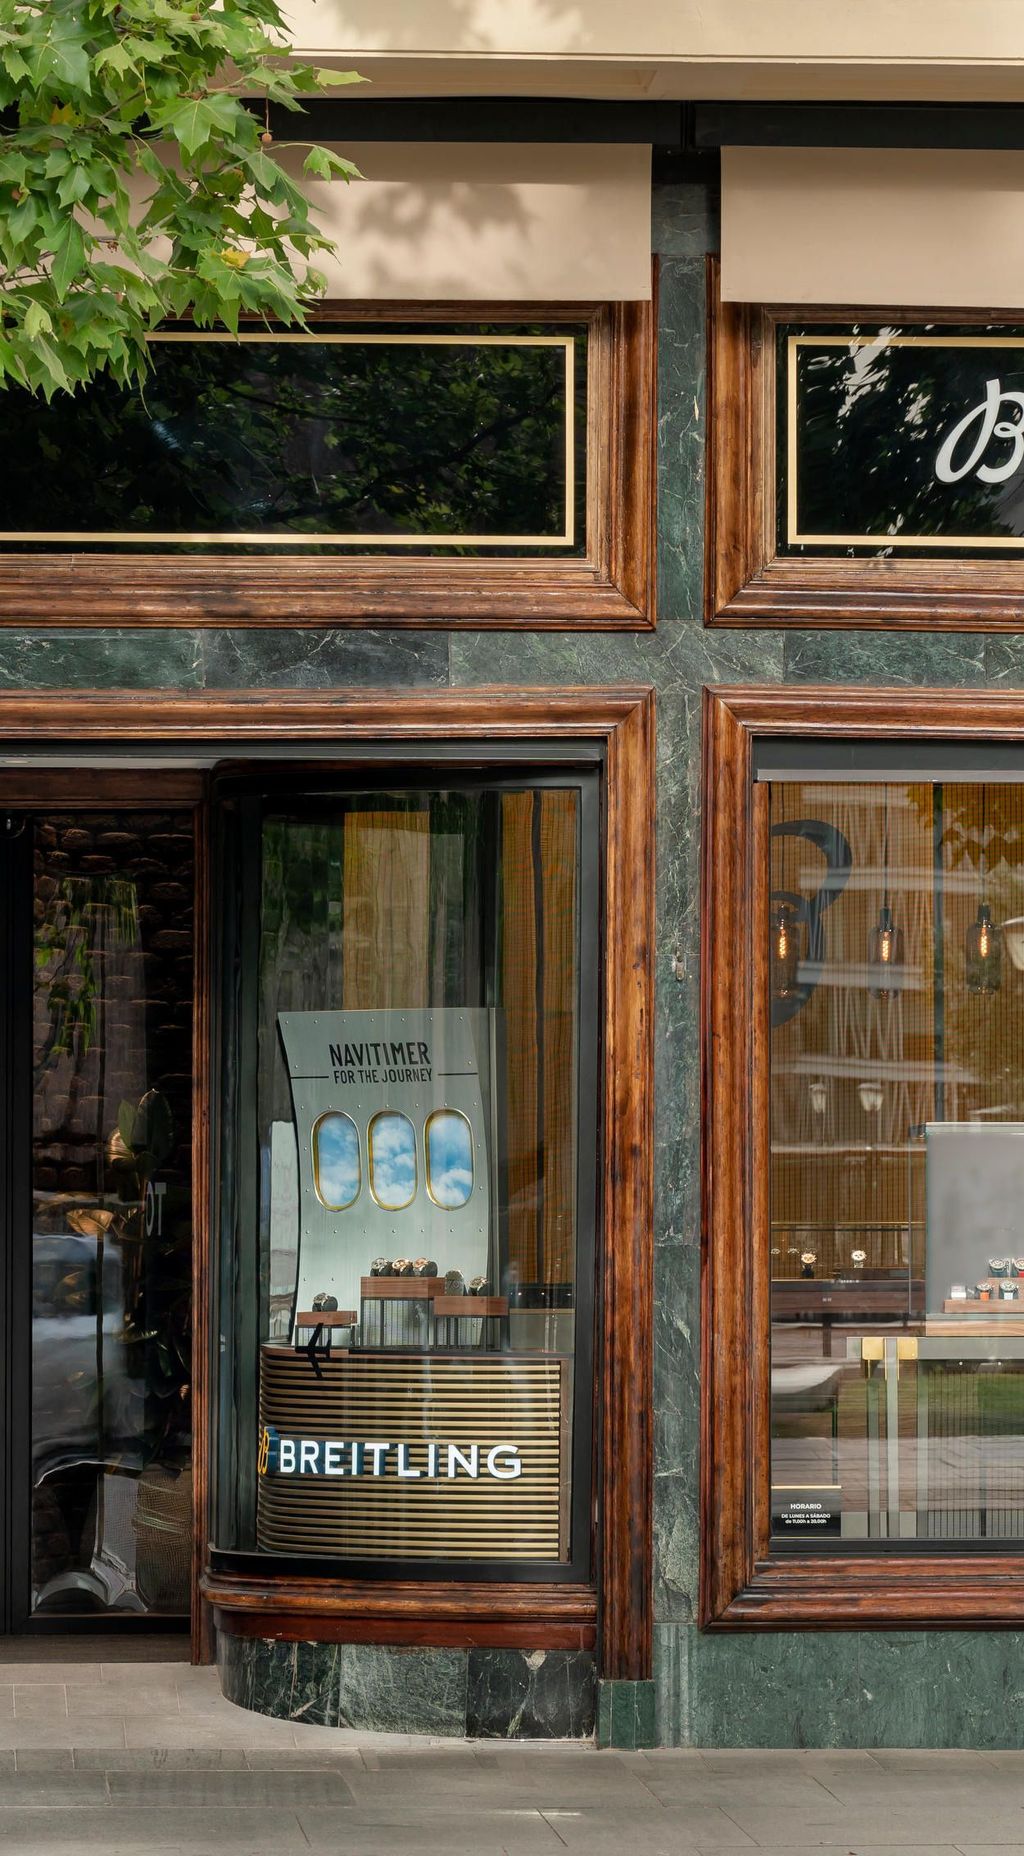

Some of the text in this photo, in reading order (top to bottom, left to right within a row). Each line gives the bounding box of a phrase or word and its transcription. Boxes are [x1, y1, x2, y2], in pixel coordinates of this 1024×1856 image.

[328, 1042, 431, 1067] NAVITIMER
[333, 1068, 432, 1085] FOR THE JOURNEY
[280, 1439, 523, 1480] BREITLING
